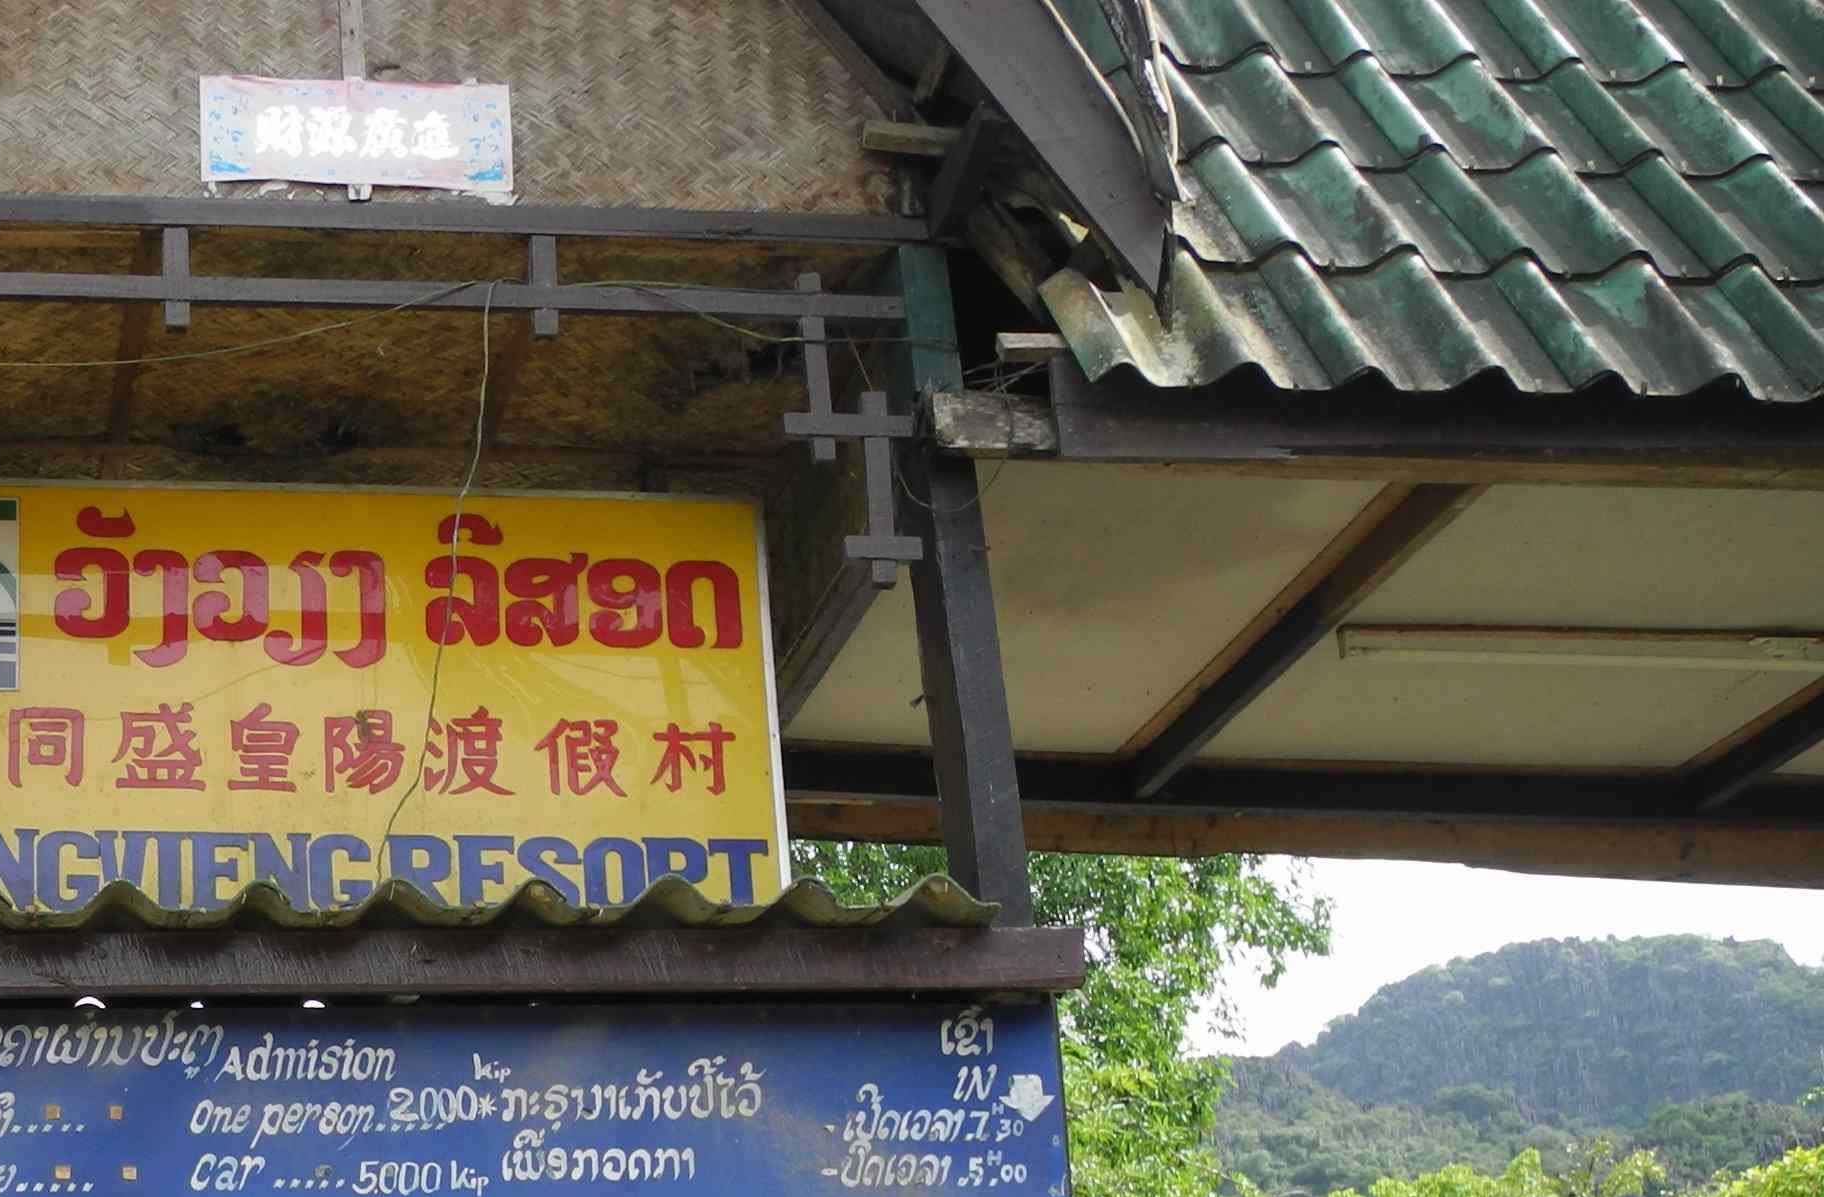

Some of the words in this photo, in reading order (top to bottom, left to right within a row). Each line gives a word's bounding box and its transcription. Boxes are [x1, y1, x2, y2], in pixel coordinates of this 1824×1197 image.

[54, 506, 387, 668] ວັງວຽງ
[215, 1033, 396, 1081] Admision
[952, 1064, 999, 1102] IN
